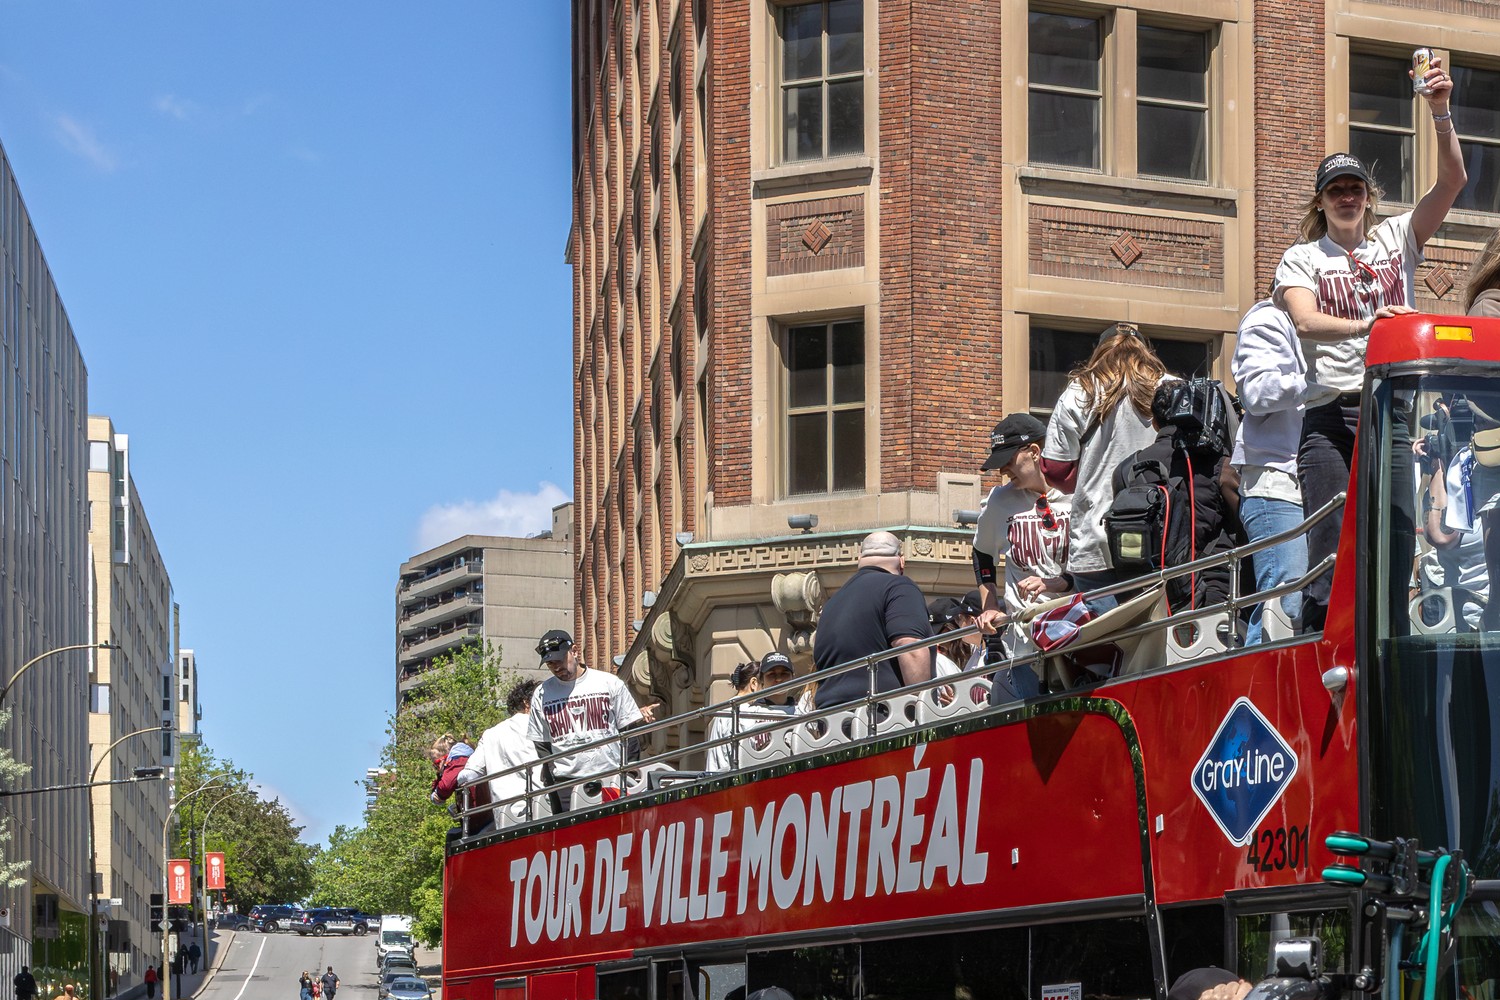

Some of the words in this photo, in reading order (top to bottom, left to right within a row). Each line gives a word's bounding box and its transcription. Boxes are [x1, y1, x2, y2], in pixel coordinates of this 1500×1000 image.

[510, 843, 586, 948] TOUR
[590, 832, 633, 936] DE
[641, 810, 733, 928] VILLE
[736, 742, 989, 915] MONTRÉAL
[1246, 824, 1310, 873] 42301
